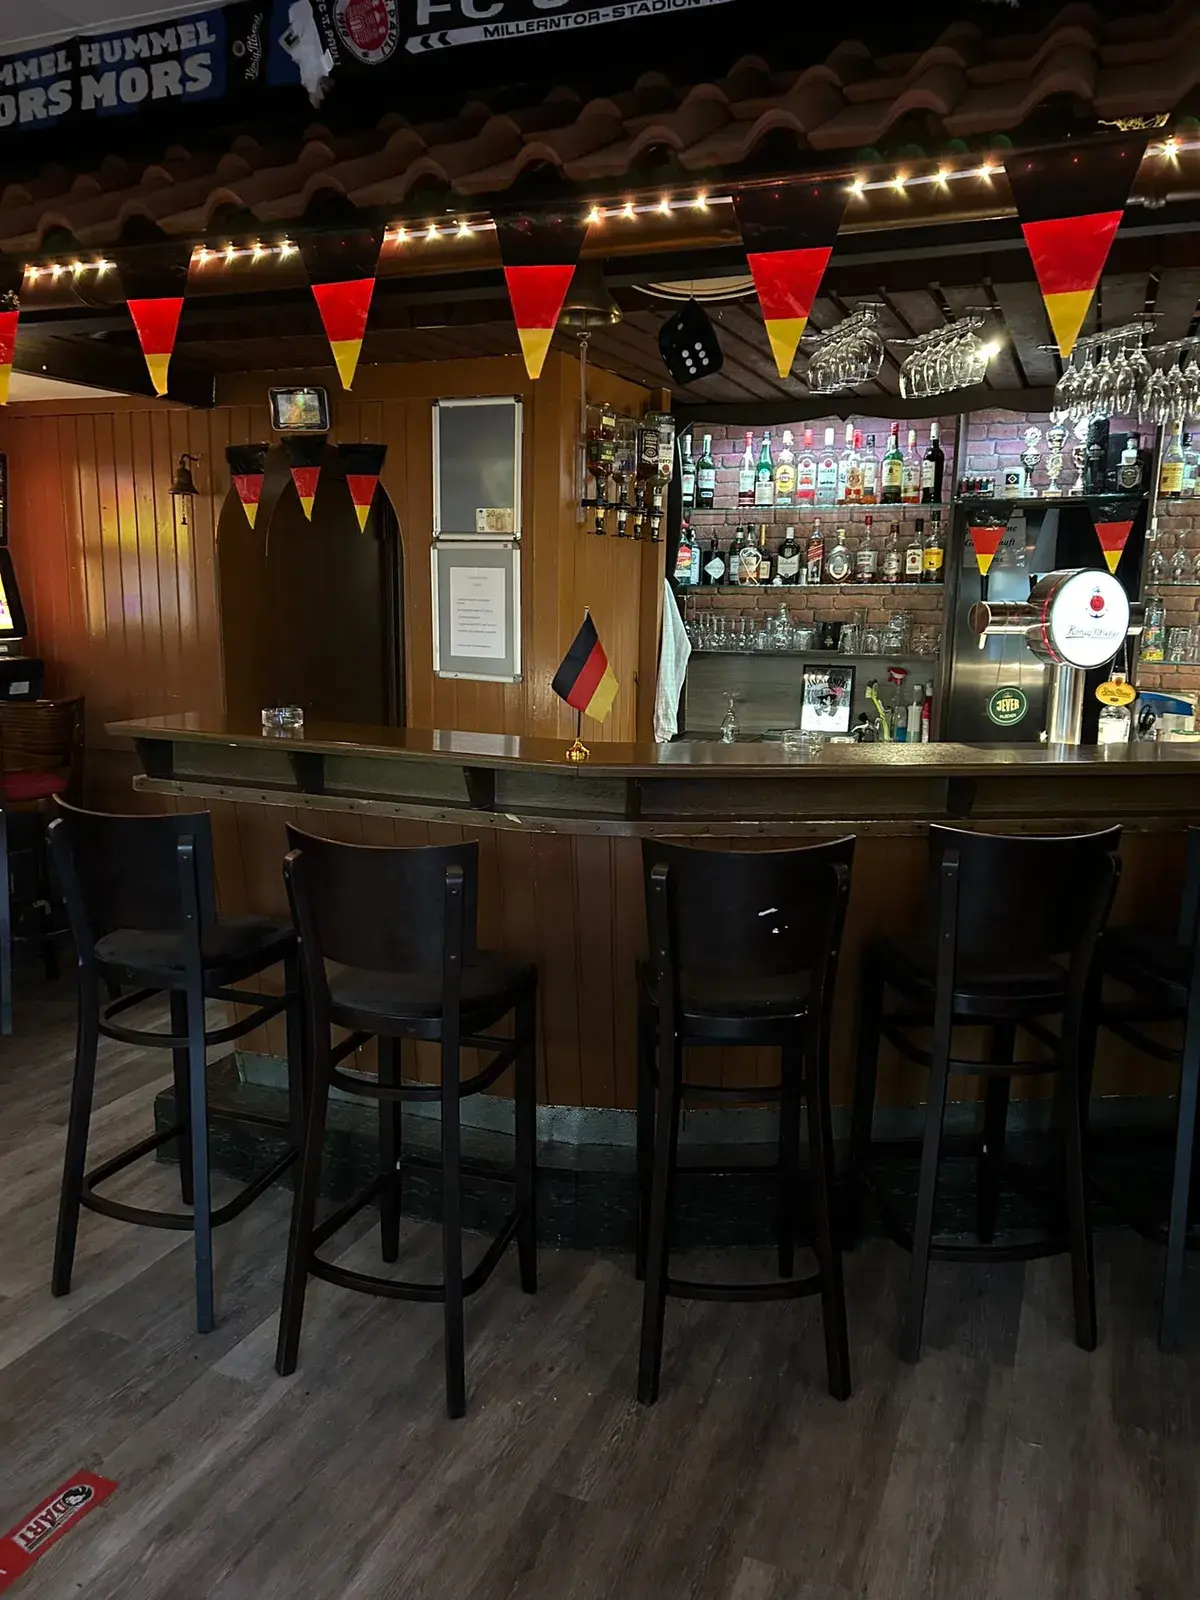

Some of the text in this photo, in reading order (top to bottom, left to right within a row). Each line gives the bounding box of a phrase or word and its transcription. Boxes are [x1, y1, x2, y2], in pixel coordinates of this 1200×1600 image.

[79, 19, 216, 68] HUMMEL
[80, 51, 213, 111] MORS
[486, 509, 495, 518] 50
[996, 698, 1020, 712] JEVER
[19, 1500, 69, 1547] DART
